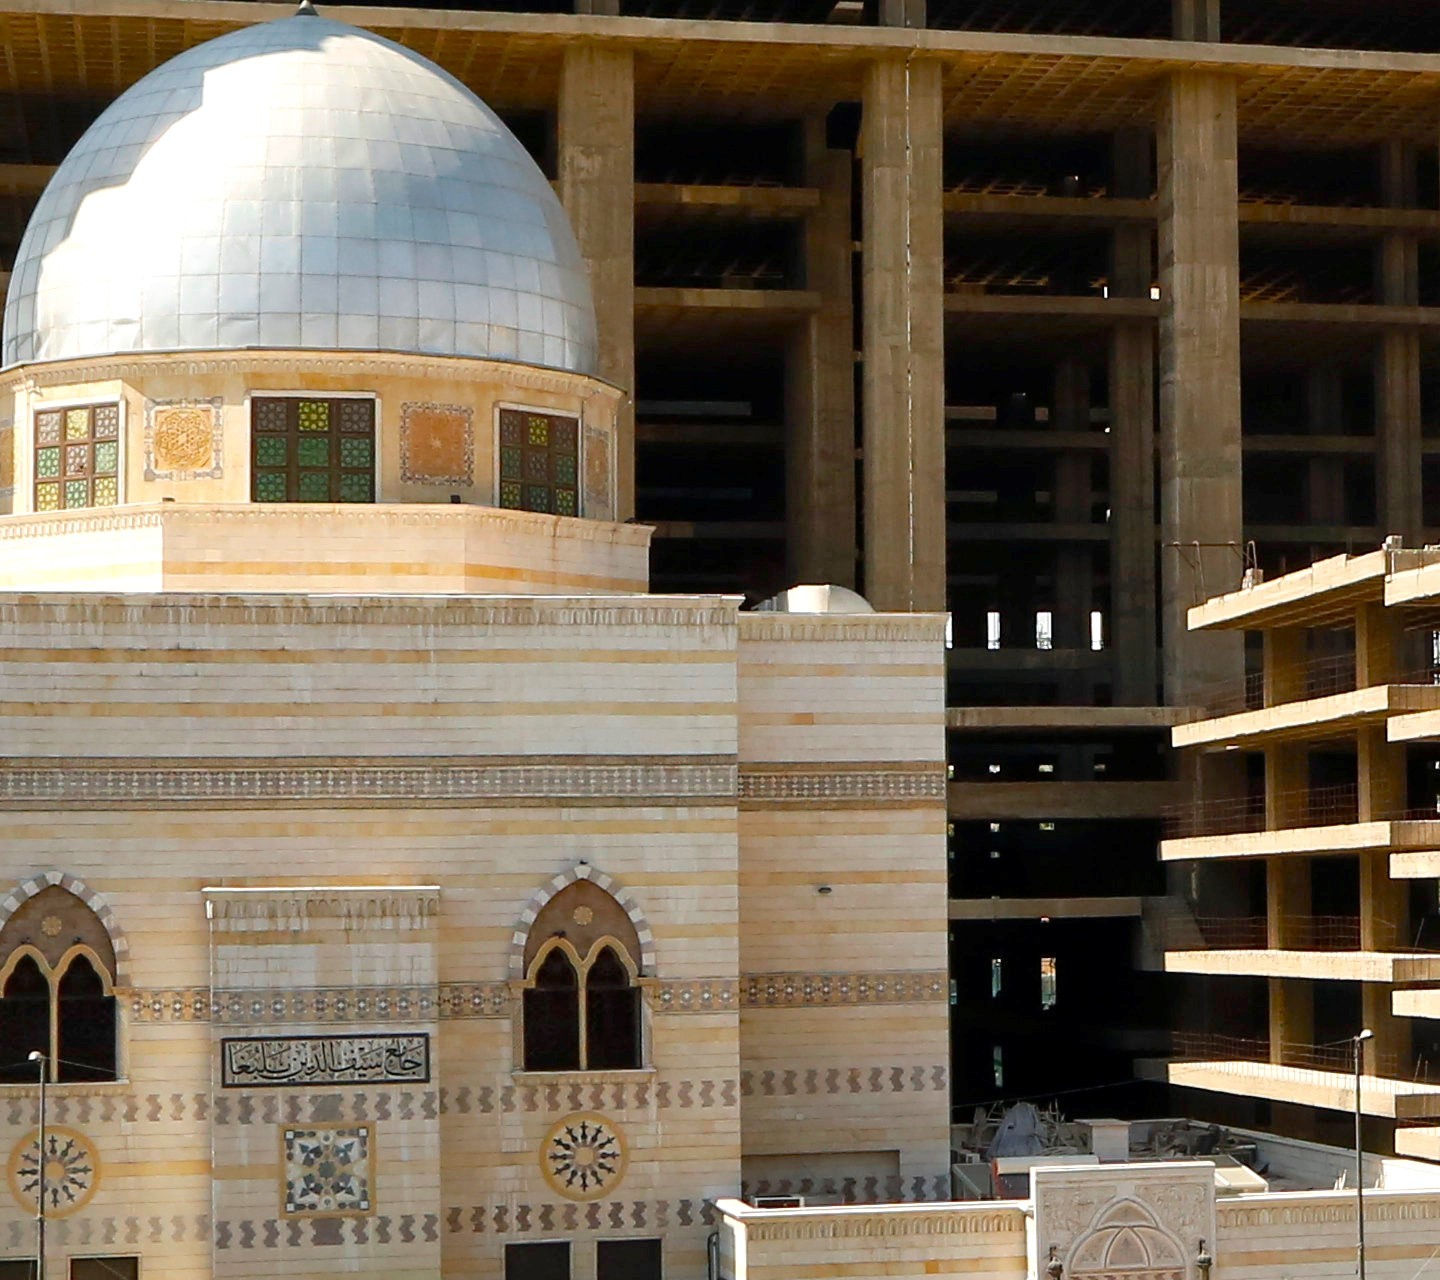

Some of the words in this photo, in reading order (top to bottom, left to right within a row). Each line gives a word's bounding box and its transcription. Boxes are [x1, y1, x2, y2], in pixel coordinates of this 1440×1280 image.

[260, 1041, 336, 1081] الدين
[329, 1046, 384, 1078] سيف
[384, 1038, 424, 1077] جامع
